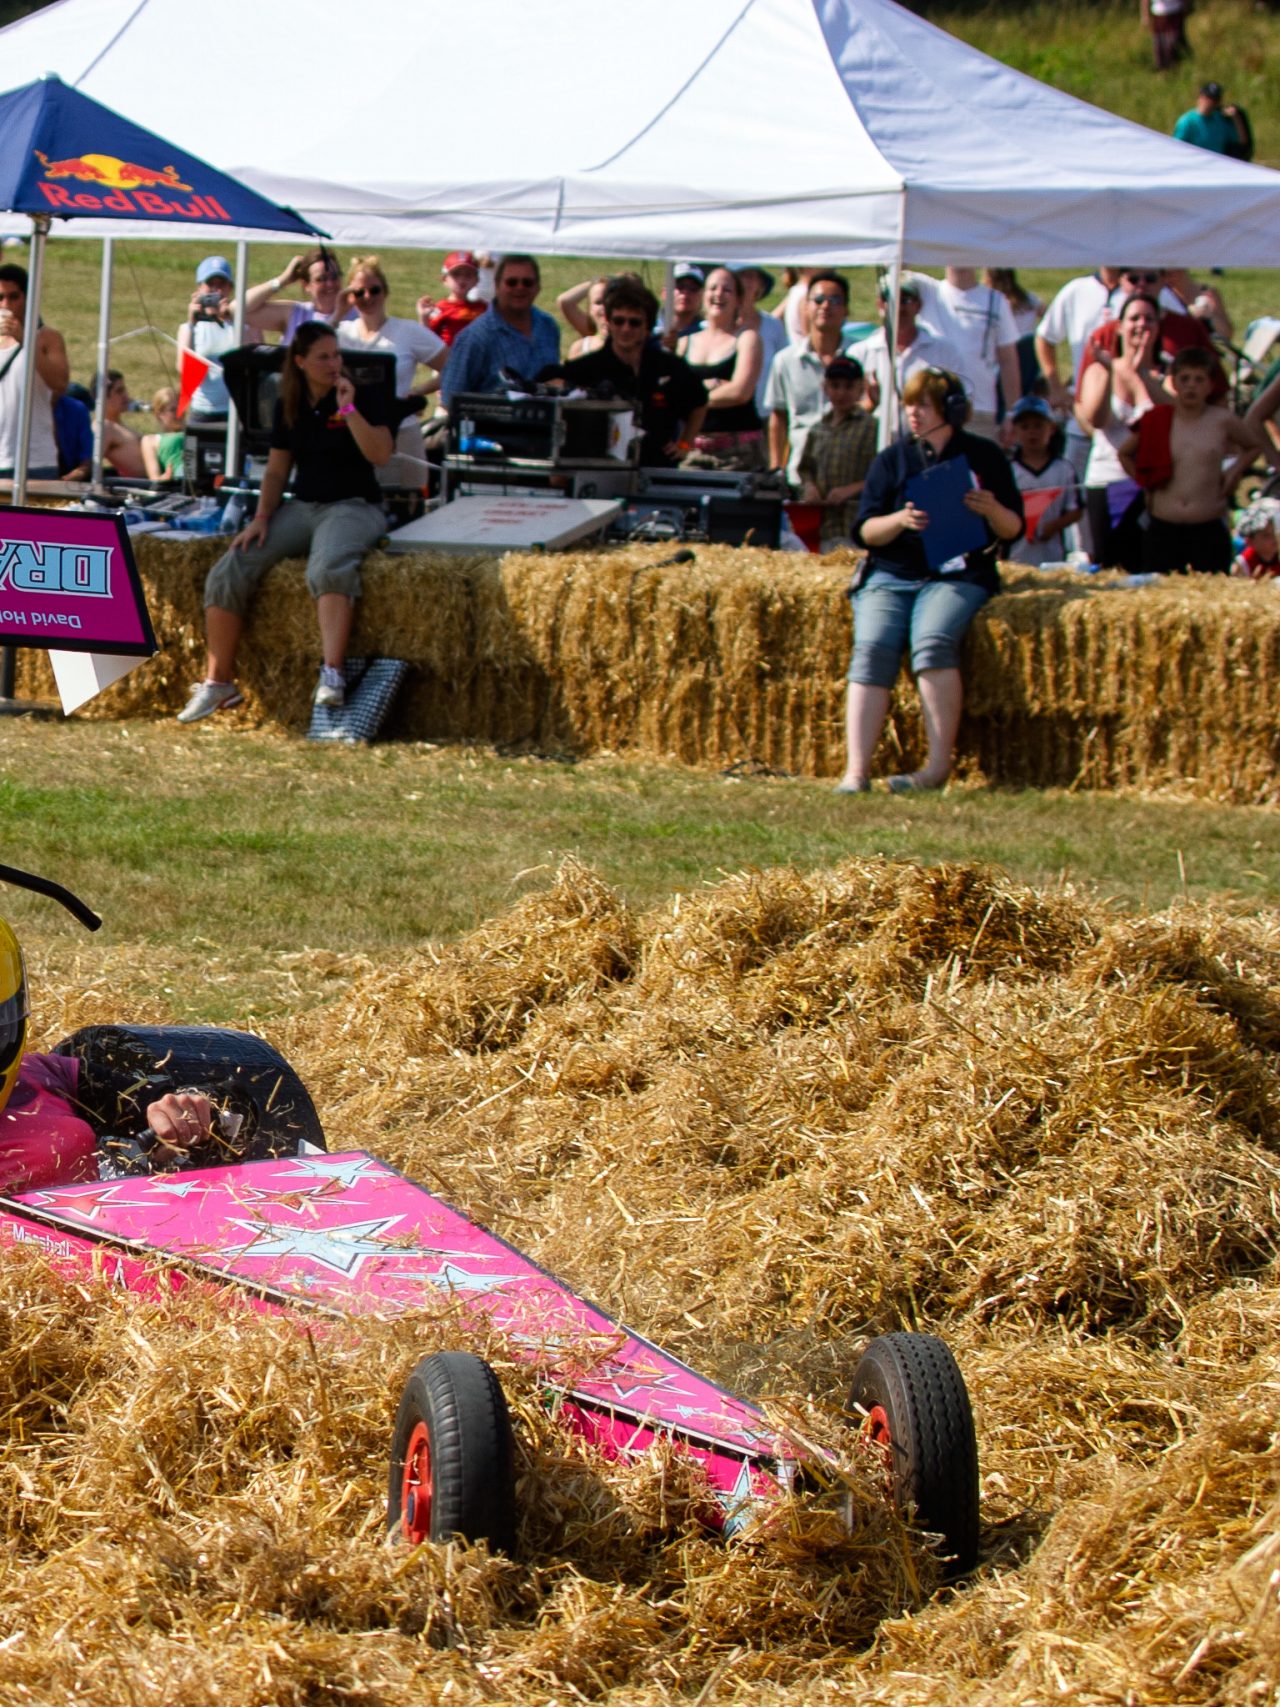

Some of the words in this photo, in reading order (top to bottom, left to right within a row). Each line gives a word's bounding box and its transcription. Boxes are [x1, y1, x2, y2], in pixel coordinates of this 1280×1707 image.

[37, 181, 138, 212] Red
[131, 190, 232, 221] Bull
[31, 611, 82, 629] David
